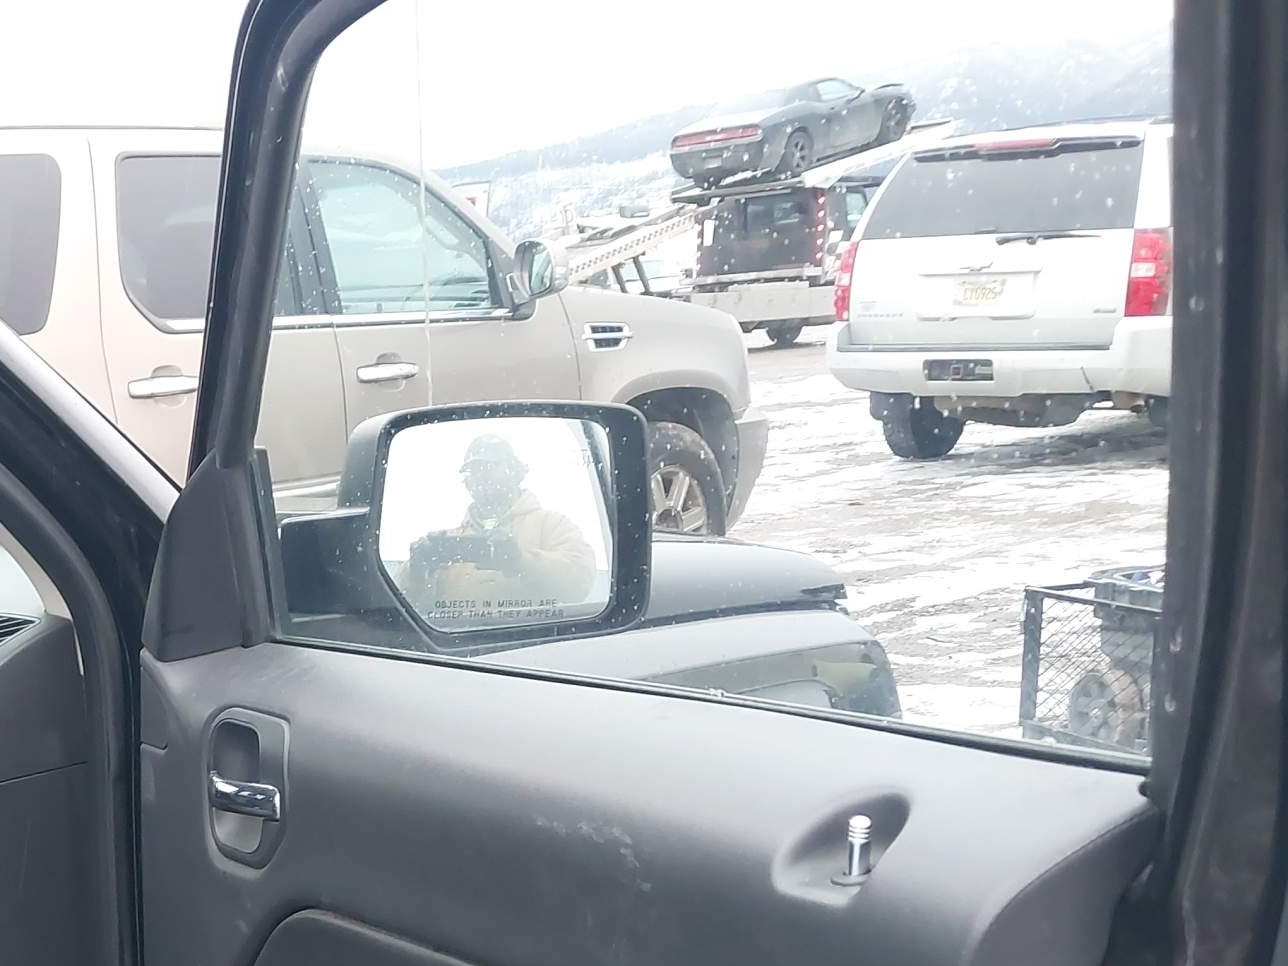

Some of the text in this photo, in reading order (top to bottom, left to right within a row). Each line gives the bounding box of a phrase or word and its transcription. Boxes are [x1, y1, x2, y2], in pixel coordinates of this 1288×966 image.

[434, 599, 558, 609] OBJECTS IN MIRROR ARE
[427, 608, 565, 620] CLOSER THAN THEY APPEAR
